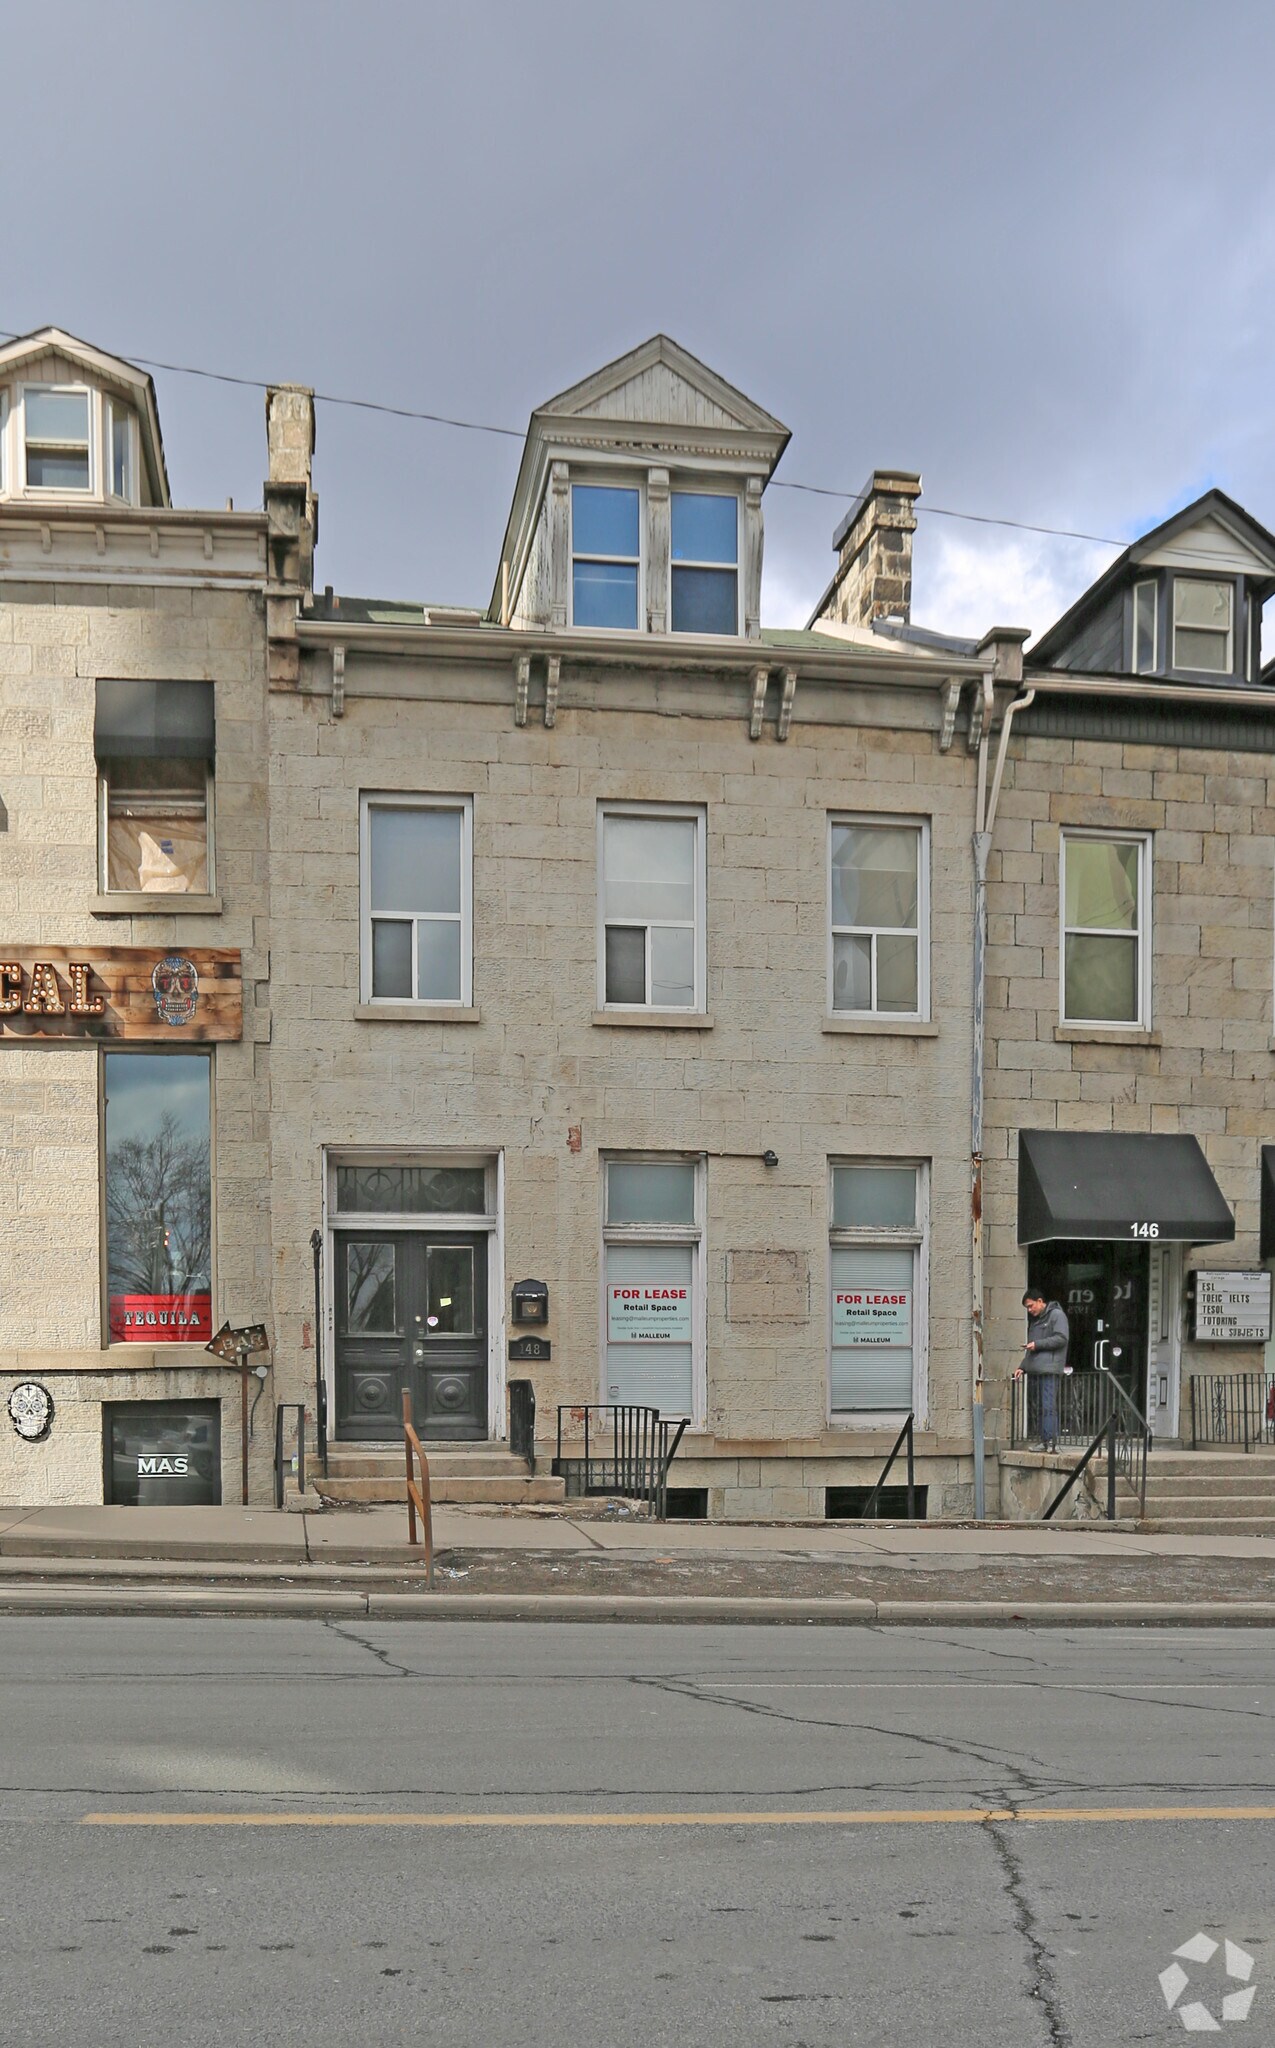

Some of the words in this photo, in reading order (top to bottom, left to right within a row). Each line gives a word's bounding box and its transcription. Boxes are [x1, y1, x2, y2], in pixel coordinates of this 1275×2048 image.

[1130, 1222, 1159, 1238] 146
[1202, 1283, 1215, 1291] ESL
[613, 1289, 640, 1299] FOR
[644, 1289, 687, 1299] LEASE
[1202, 1294, 1223, 1303] TOEIC
[1229, 1294, 1250, 1303] IELTS
[836, 1295, 862, 1304] FOR
[866, 1295, 906, 1305] LEASE
[651, 1304, 677, 1312] Space
[1203, 1305, 1223, 1314] TESOL
[872, 1309, 897, 1317] Space
[124, 1311, 200, 1326] TEQUILA
[1203, 1317, 1238, 1325] TUTORING
[1211, 1328, 1224, 1336] ALL
[222, 1333, 265, 1350] BAR
[520, 1343, 540, 1355] 148
[138, 1457, 188, 1474] MAS
